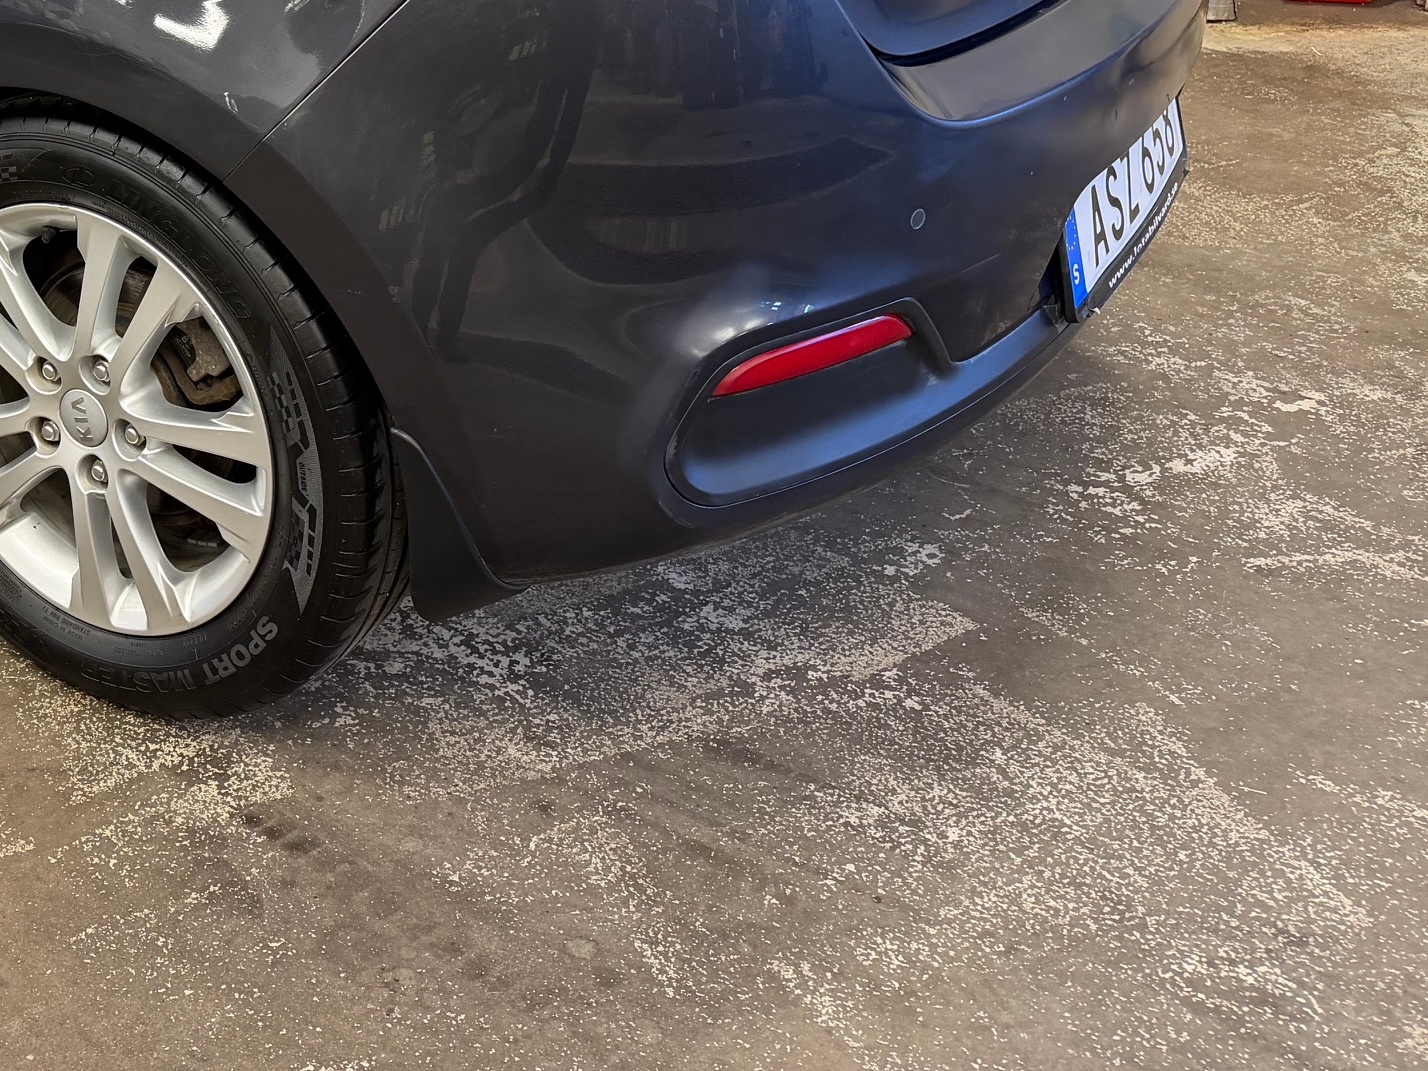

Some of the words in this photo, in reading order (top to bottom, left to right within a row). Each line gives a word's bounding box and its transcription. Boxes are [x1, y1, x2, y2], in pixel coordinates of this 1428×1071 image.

[1072, 263, 1080, 285] S
[70, 396, 94, 442] KIA
[202, 614, 279, 686] SPORT
[80, 656, 198, 693] MASTER
